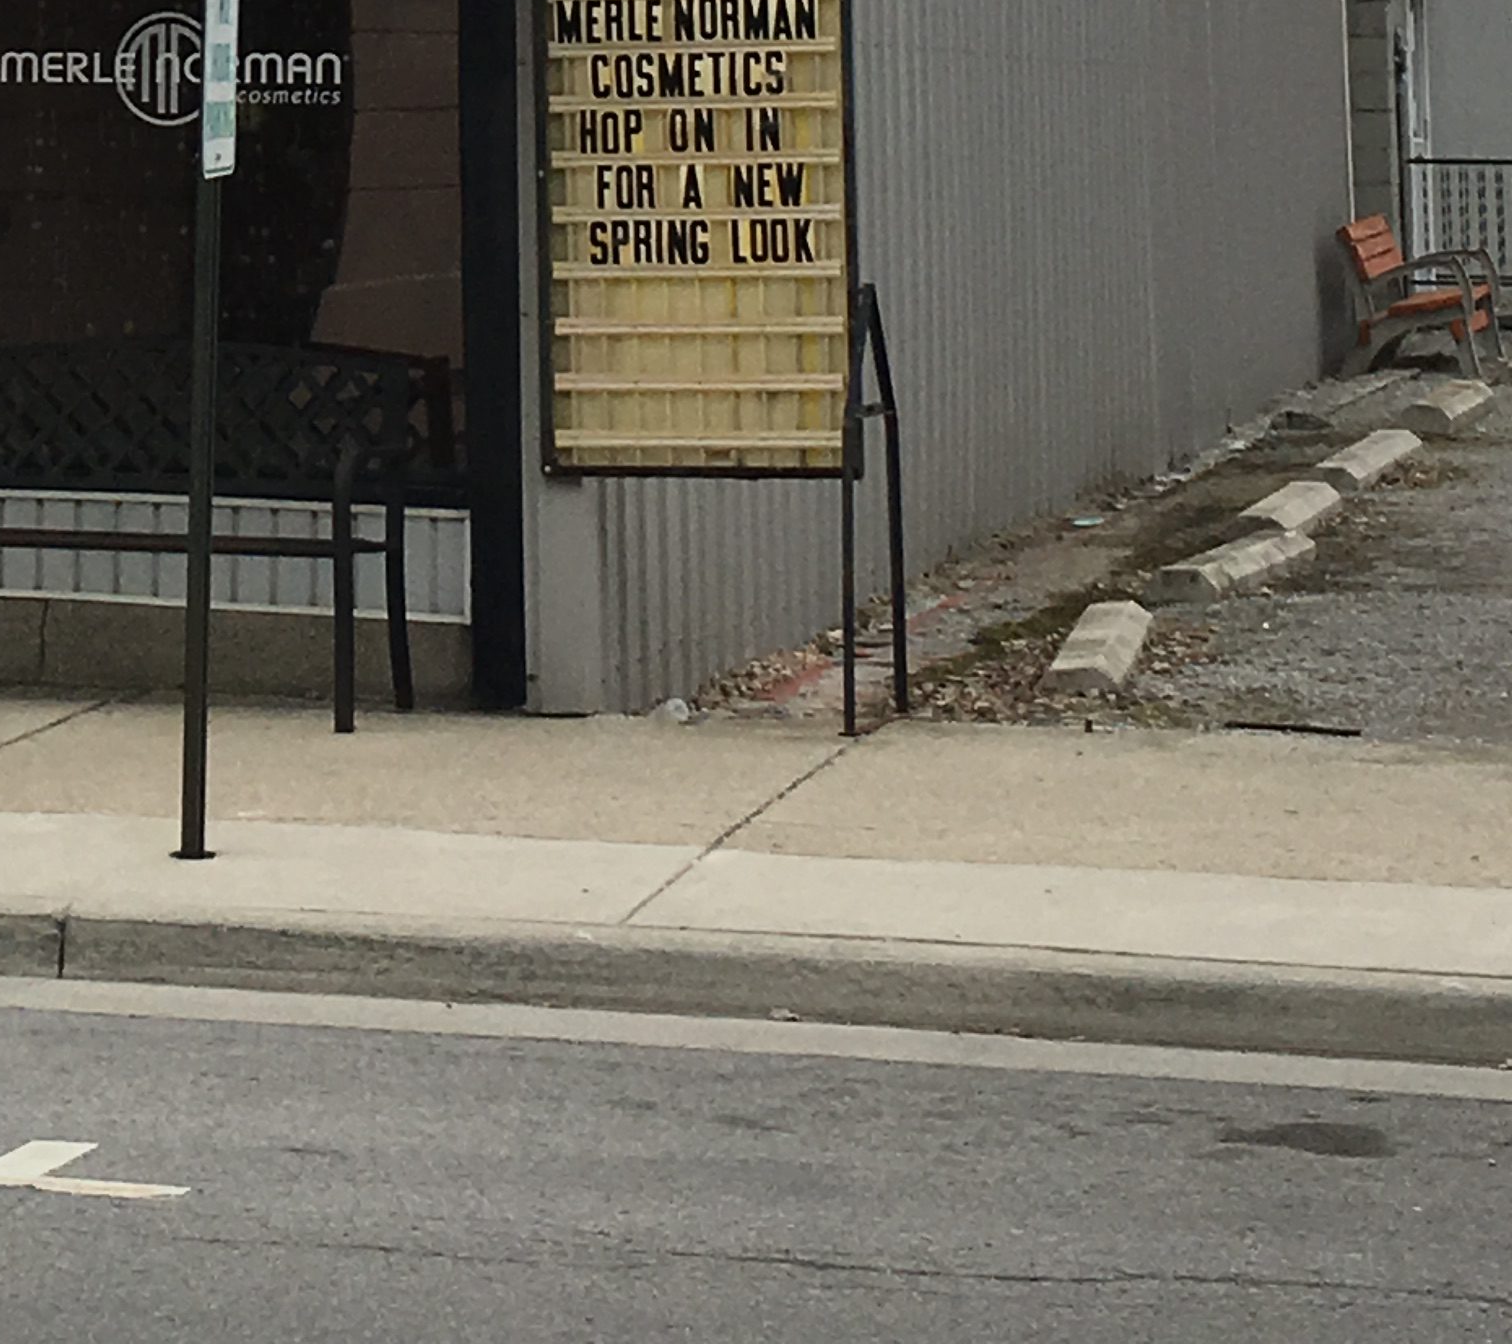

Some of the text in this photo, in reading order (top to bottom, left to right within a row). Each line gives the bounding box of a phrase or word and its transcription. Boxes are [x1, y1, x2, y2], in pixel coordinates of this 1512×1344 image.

[0, 51, 341, 85] MERLE NOMAN
[590, 50, 785, 99] COSMETICS
[235, 86, 342, 105] cosmetics
[579, 107, 781, 155] HOP ON IN
[595, 163, 805, 210] FOR A NEW
[589, 218, 816, 265] SPRING LOOK
